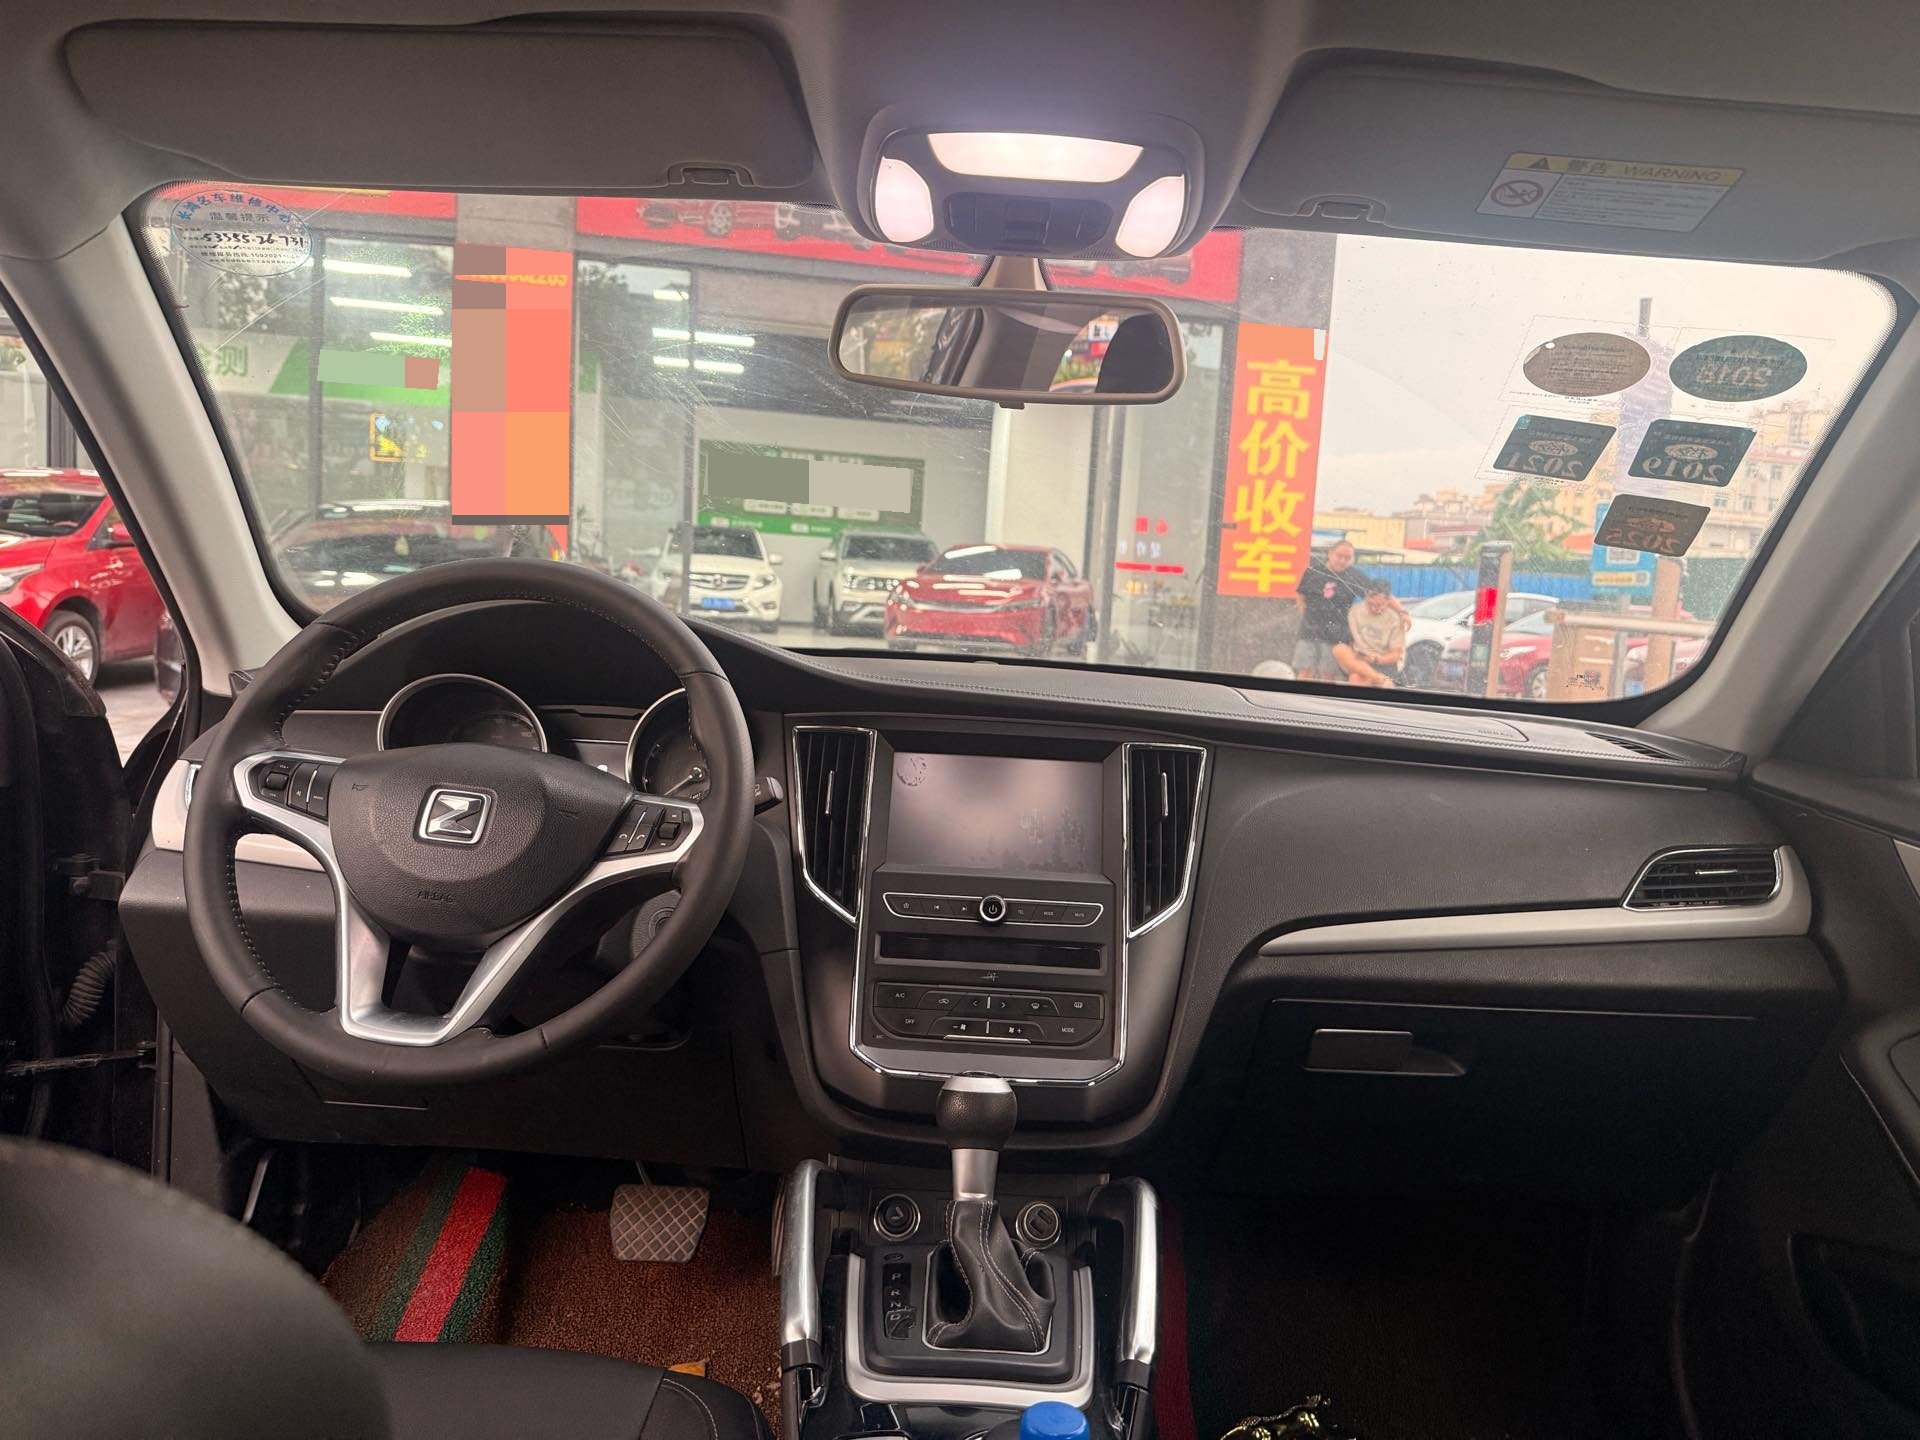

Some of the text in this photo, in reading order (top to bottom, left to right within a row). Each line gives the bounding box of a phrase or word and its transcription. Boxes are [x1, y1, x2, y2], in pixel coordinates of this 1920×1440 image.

[1623, 164, 1721, 182] WARNING
[1227, 359, 1317, 593] 高价收车
